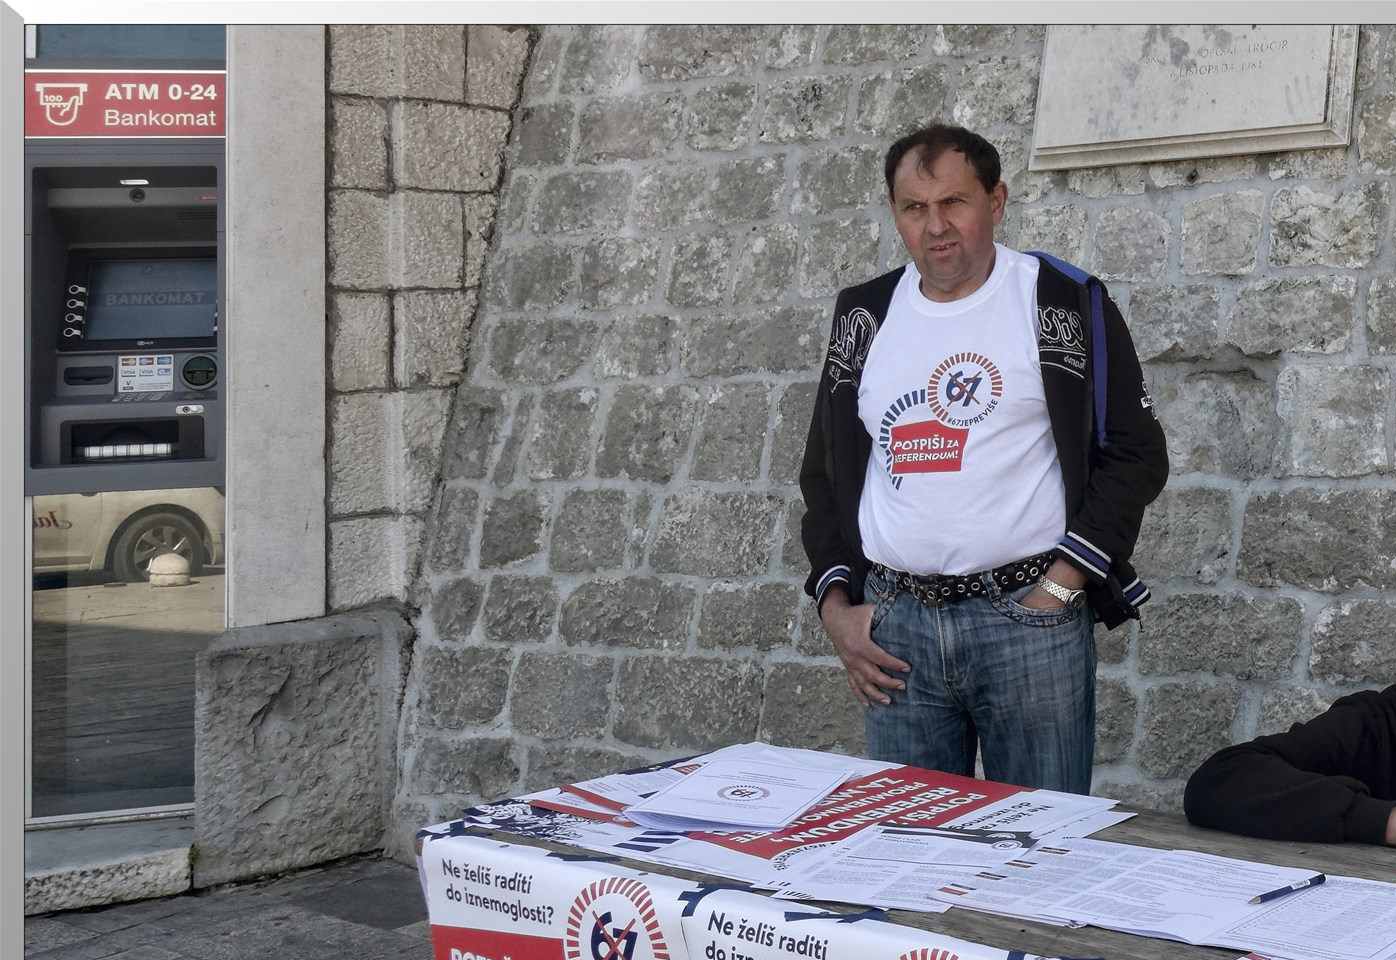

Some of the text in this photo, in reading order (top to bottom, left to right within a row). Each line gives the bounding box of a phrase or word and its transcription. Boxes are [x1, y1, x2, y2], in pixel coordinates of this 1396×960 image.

[105, 84, 217, 100] ATM 0-24
[105, 109, 217, 126] Bankomat
[106, 293, 206, 306] BANKOMAT
[946, 371, 983, 407] 67
[947, 398, 998, 427] #67JEPREVIŠE
[893, 434, 959, 451] POTPIŠI ZA
[894, 450, 959, 463] REFERENDUM!
[769, 787, 960, 843] REFERENDUM,
[899, 793, 988, 821] POTPIŠI
[442, 858, 533, 894] Ne želiš raditi
[446, 884, 555, 925] do iznemoglosti?
[707, 910, 829, 960] Ne želiš raditi
